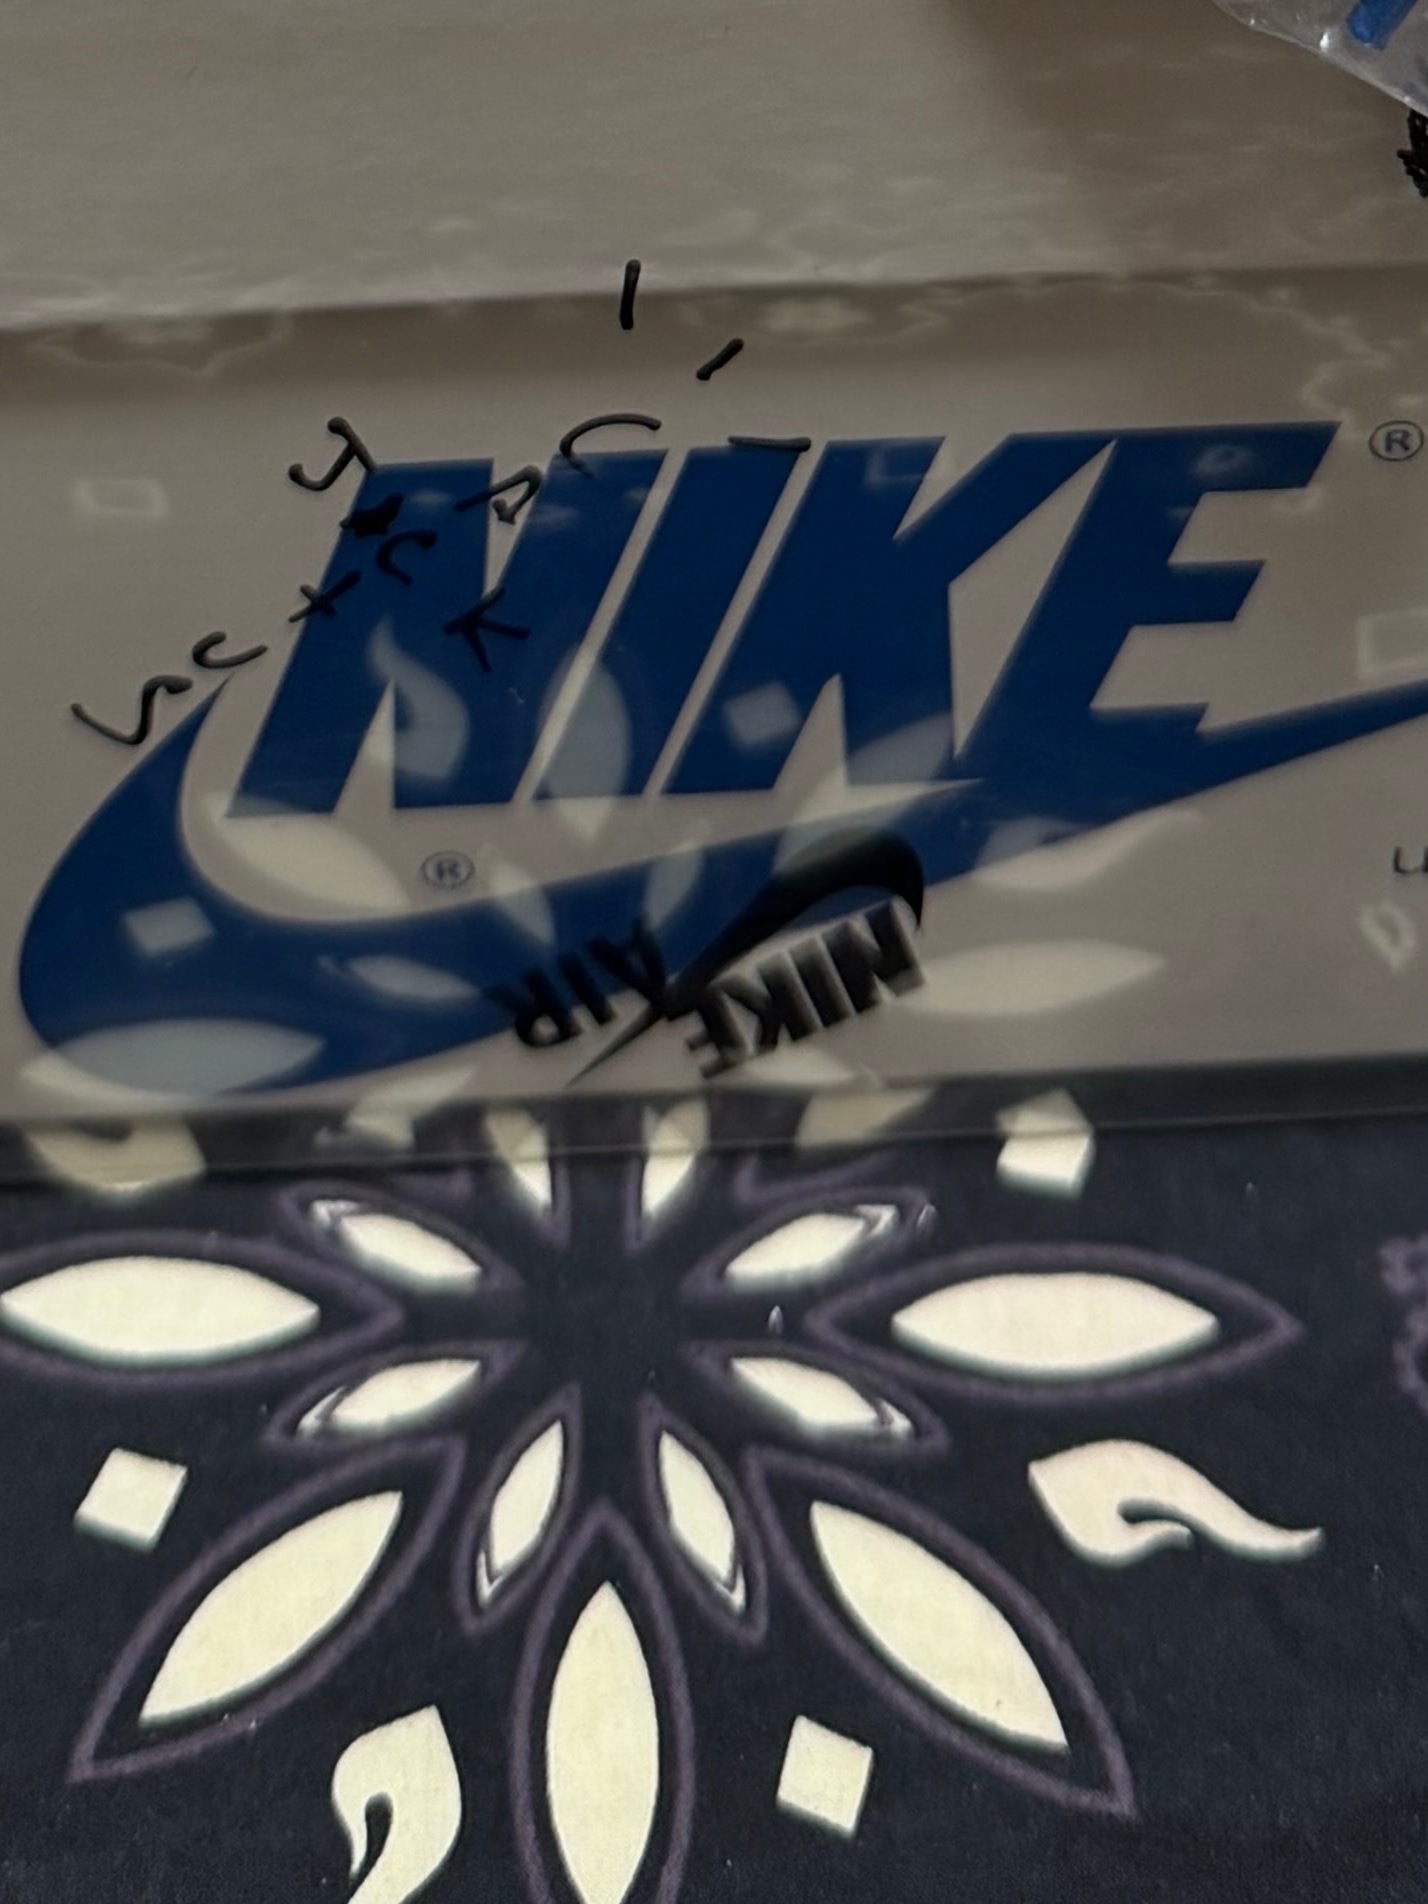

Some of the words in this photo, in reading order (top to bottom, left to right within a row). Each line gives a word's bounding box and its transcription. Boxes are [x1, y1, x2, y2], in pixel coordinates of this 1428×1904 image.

[222, 421, 1342, 818] NIKE
[488, 917, 673, 1047] AIR
[684, 896, 925, 1078] NIKE
